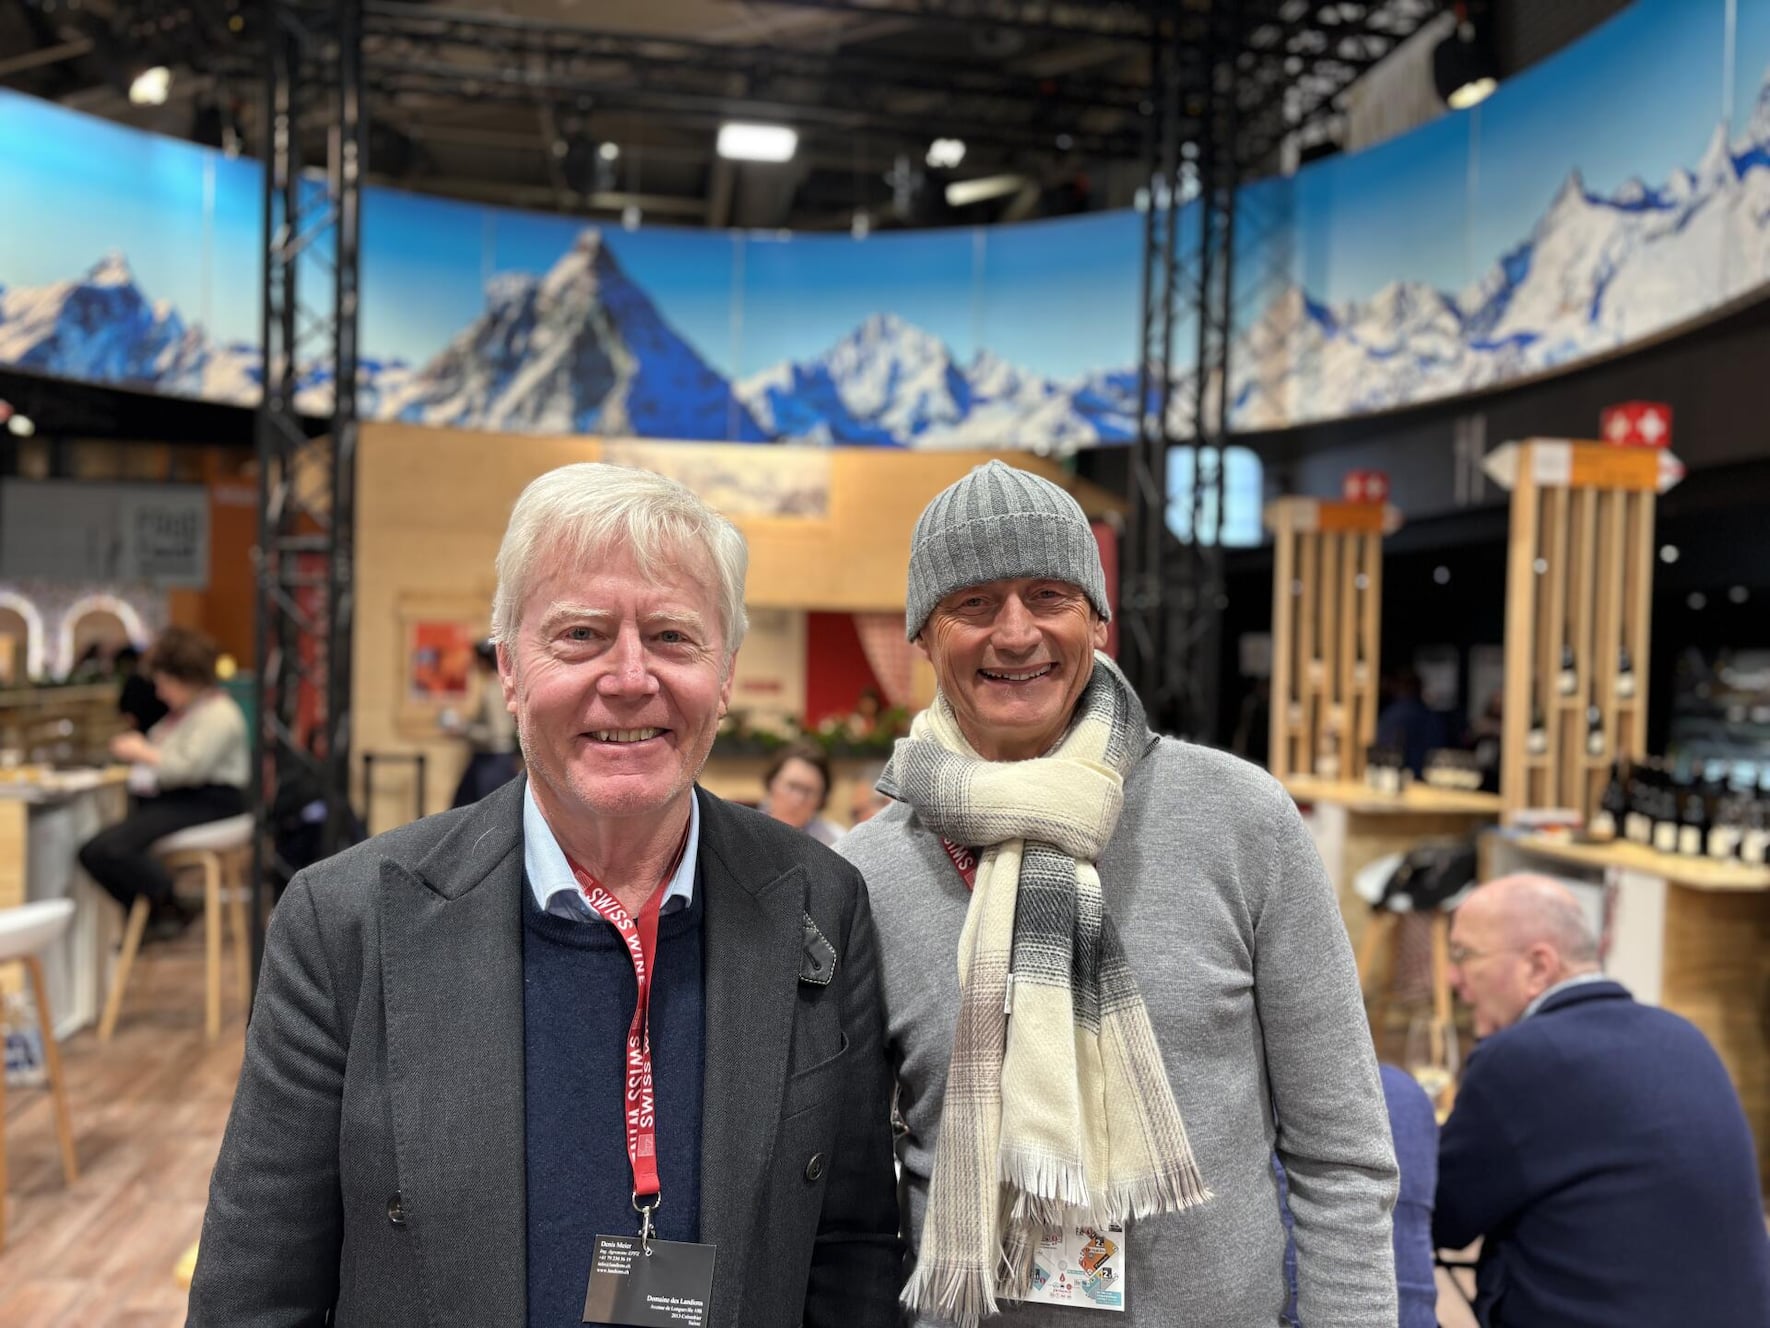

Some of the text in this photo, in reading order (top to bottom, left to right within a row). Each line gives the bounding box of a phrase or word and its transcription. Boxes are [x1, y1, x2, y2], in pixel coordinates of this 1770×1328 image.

[586, 887, 634, 931] SWISS
[627, 1035, 643, 1102] SWISS
[639, 1060, 654, 1129] SWISS
[647, 1295, 670, 1303] Domaine
[680, 1298, 703, 1306] Landions
